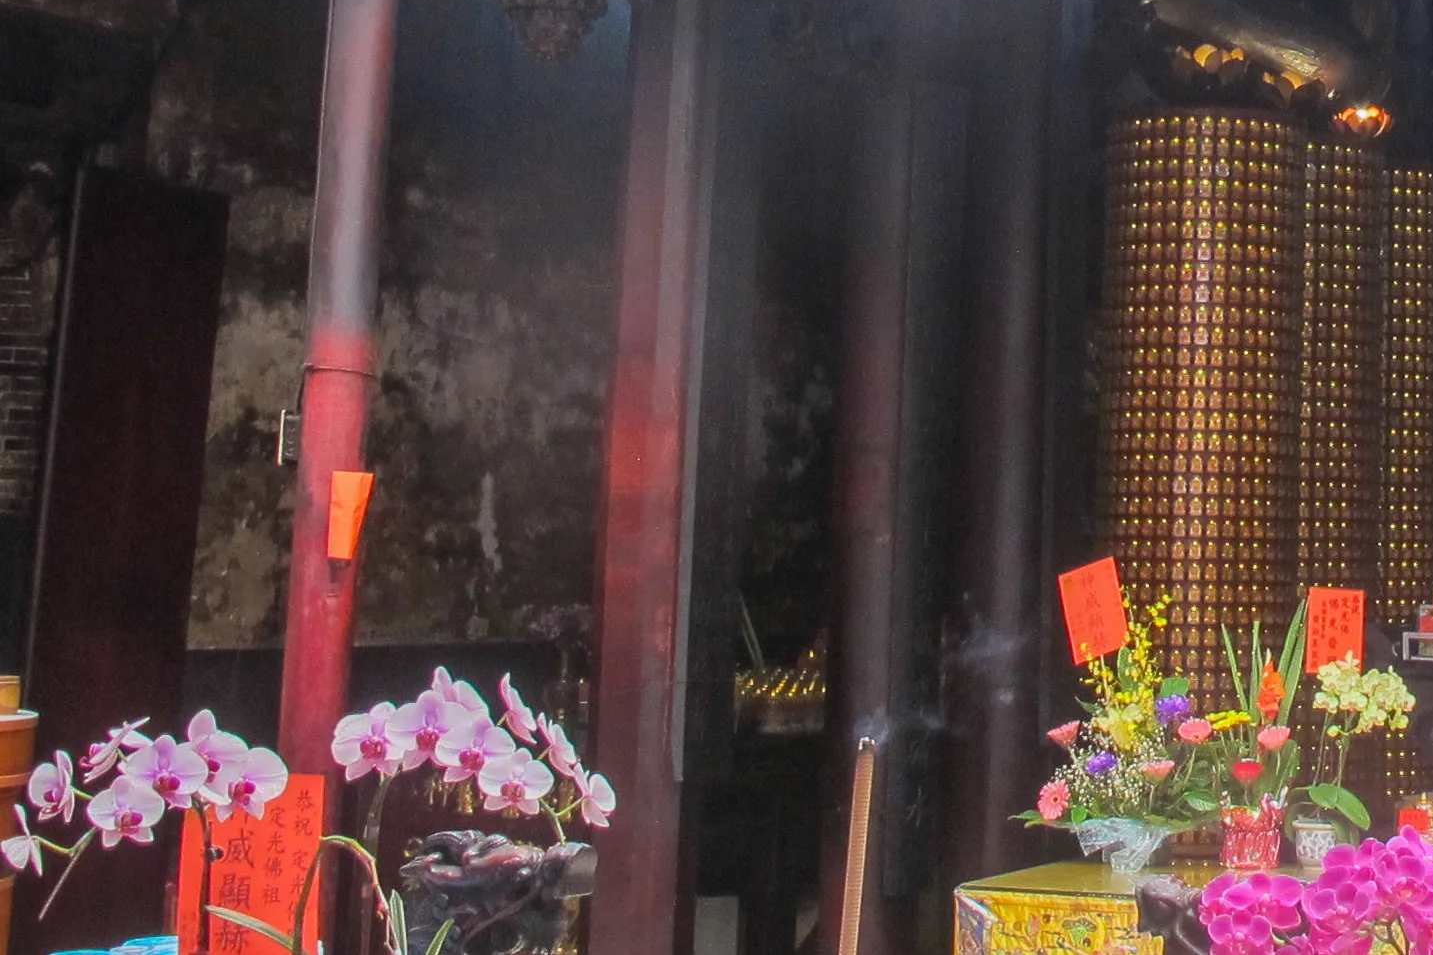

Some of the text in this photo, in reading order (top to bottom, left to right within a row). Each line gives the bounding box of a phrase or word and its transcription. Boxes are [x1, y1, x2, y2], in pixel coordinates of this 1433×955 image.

[262, 806, 286, 905] 定光佛祖
[295, 789, 315, 837] 恭祝
[213, 810, 256, 955] 威顯赫
